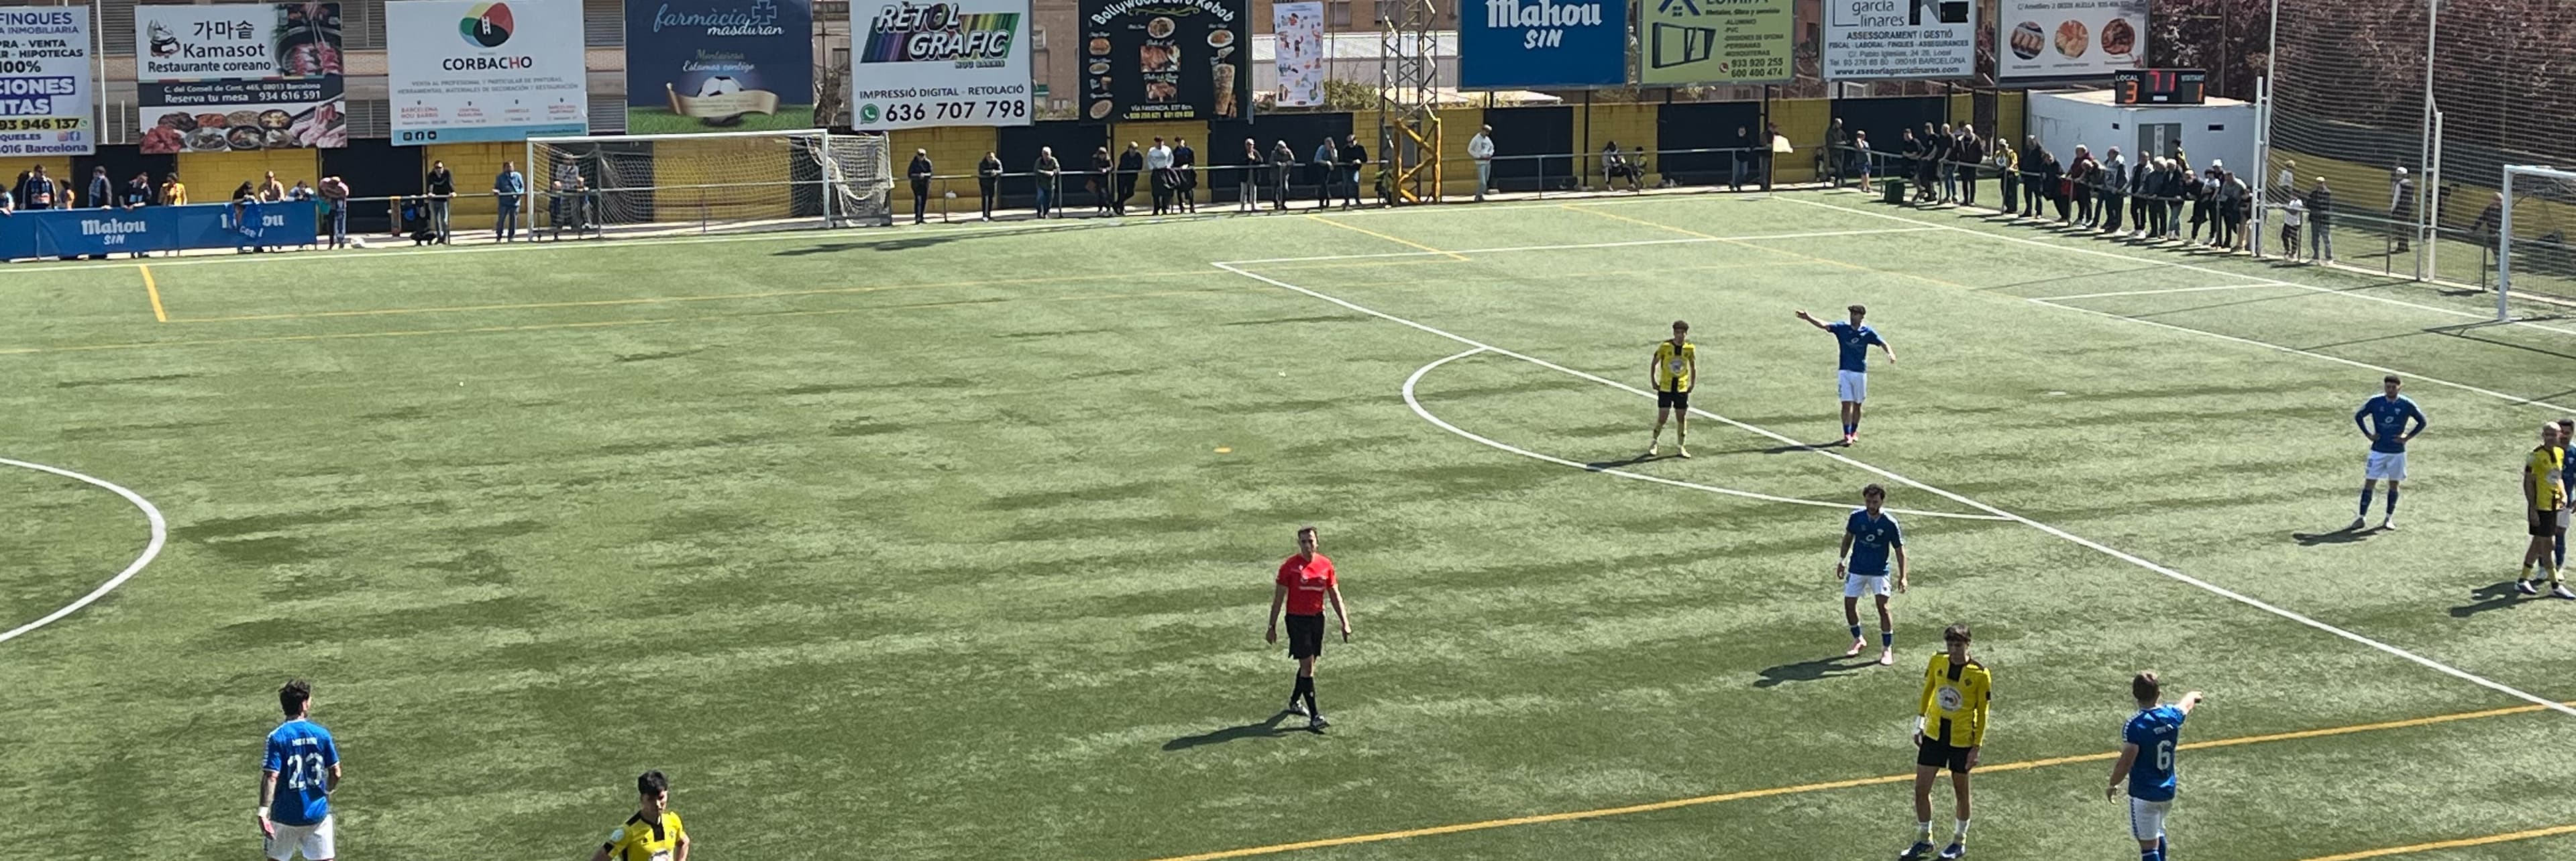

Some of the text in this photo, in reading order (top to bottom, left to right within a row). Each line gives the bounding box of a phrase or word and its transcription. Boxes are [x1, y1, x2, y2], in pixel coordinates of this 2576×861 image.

[653, 3, 754, 32] farmàcia
[876, 1, 961, 32] RÈTOL
[1485, 0, 1603, 28] Mahou
[1860, 14, 1904, 28] linares
[8, 26, 79, 34] INMOBILIARIA
[707, 19, 784, 36] masduran
[1847, 31, 1917, 40] ASSESSORAMENT
[1924, 29, 1953, 38] GESTIÓ
[28, 40, 66, 48] VENTA
[908, 30, 1010, 60] GRAFIC
[1523, 29, 1563, 49] SIN
[19, 49, 83, 58] HIPOTECAS
[183, 43, 266, 58] Kamasot
[148, 61, 271, 72] Restaurante coreano
[443, 56, 532, 70] CORBACHO
[683, 60, 755, 73] Estamos contigo
[1919, 56, 1966, 64] BARCELONA
[0, 78, 74, 95] IONES
[2149, 70, 2176, 92] 71
[165, 95, 205, 103] Reserva
[259, 92, 278, 101] 934
[281, 91, 300, 99] 616
[303, 91, 320, 99] 591
[860, 84, 1024, 99] IMPRESSIÓ DIGITAL RETOLACIÓ
[2125, 81, 2204, 103] 3 1
[885, 100, 1026, 122] 636 707 798
[21, 119, 50, 130] 946
[55, 118, 79, 129] 137
[25, 144, 88, 153] Barcelona
[81, 218, 146, 234] Mahou
[103, 234, 125, 244] SIN
[2157, 740, 2171, 770] 6
[287, 752, 324, 791] 23
